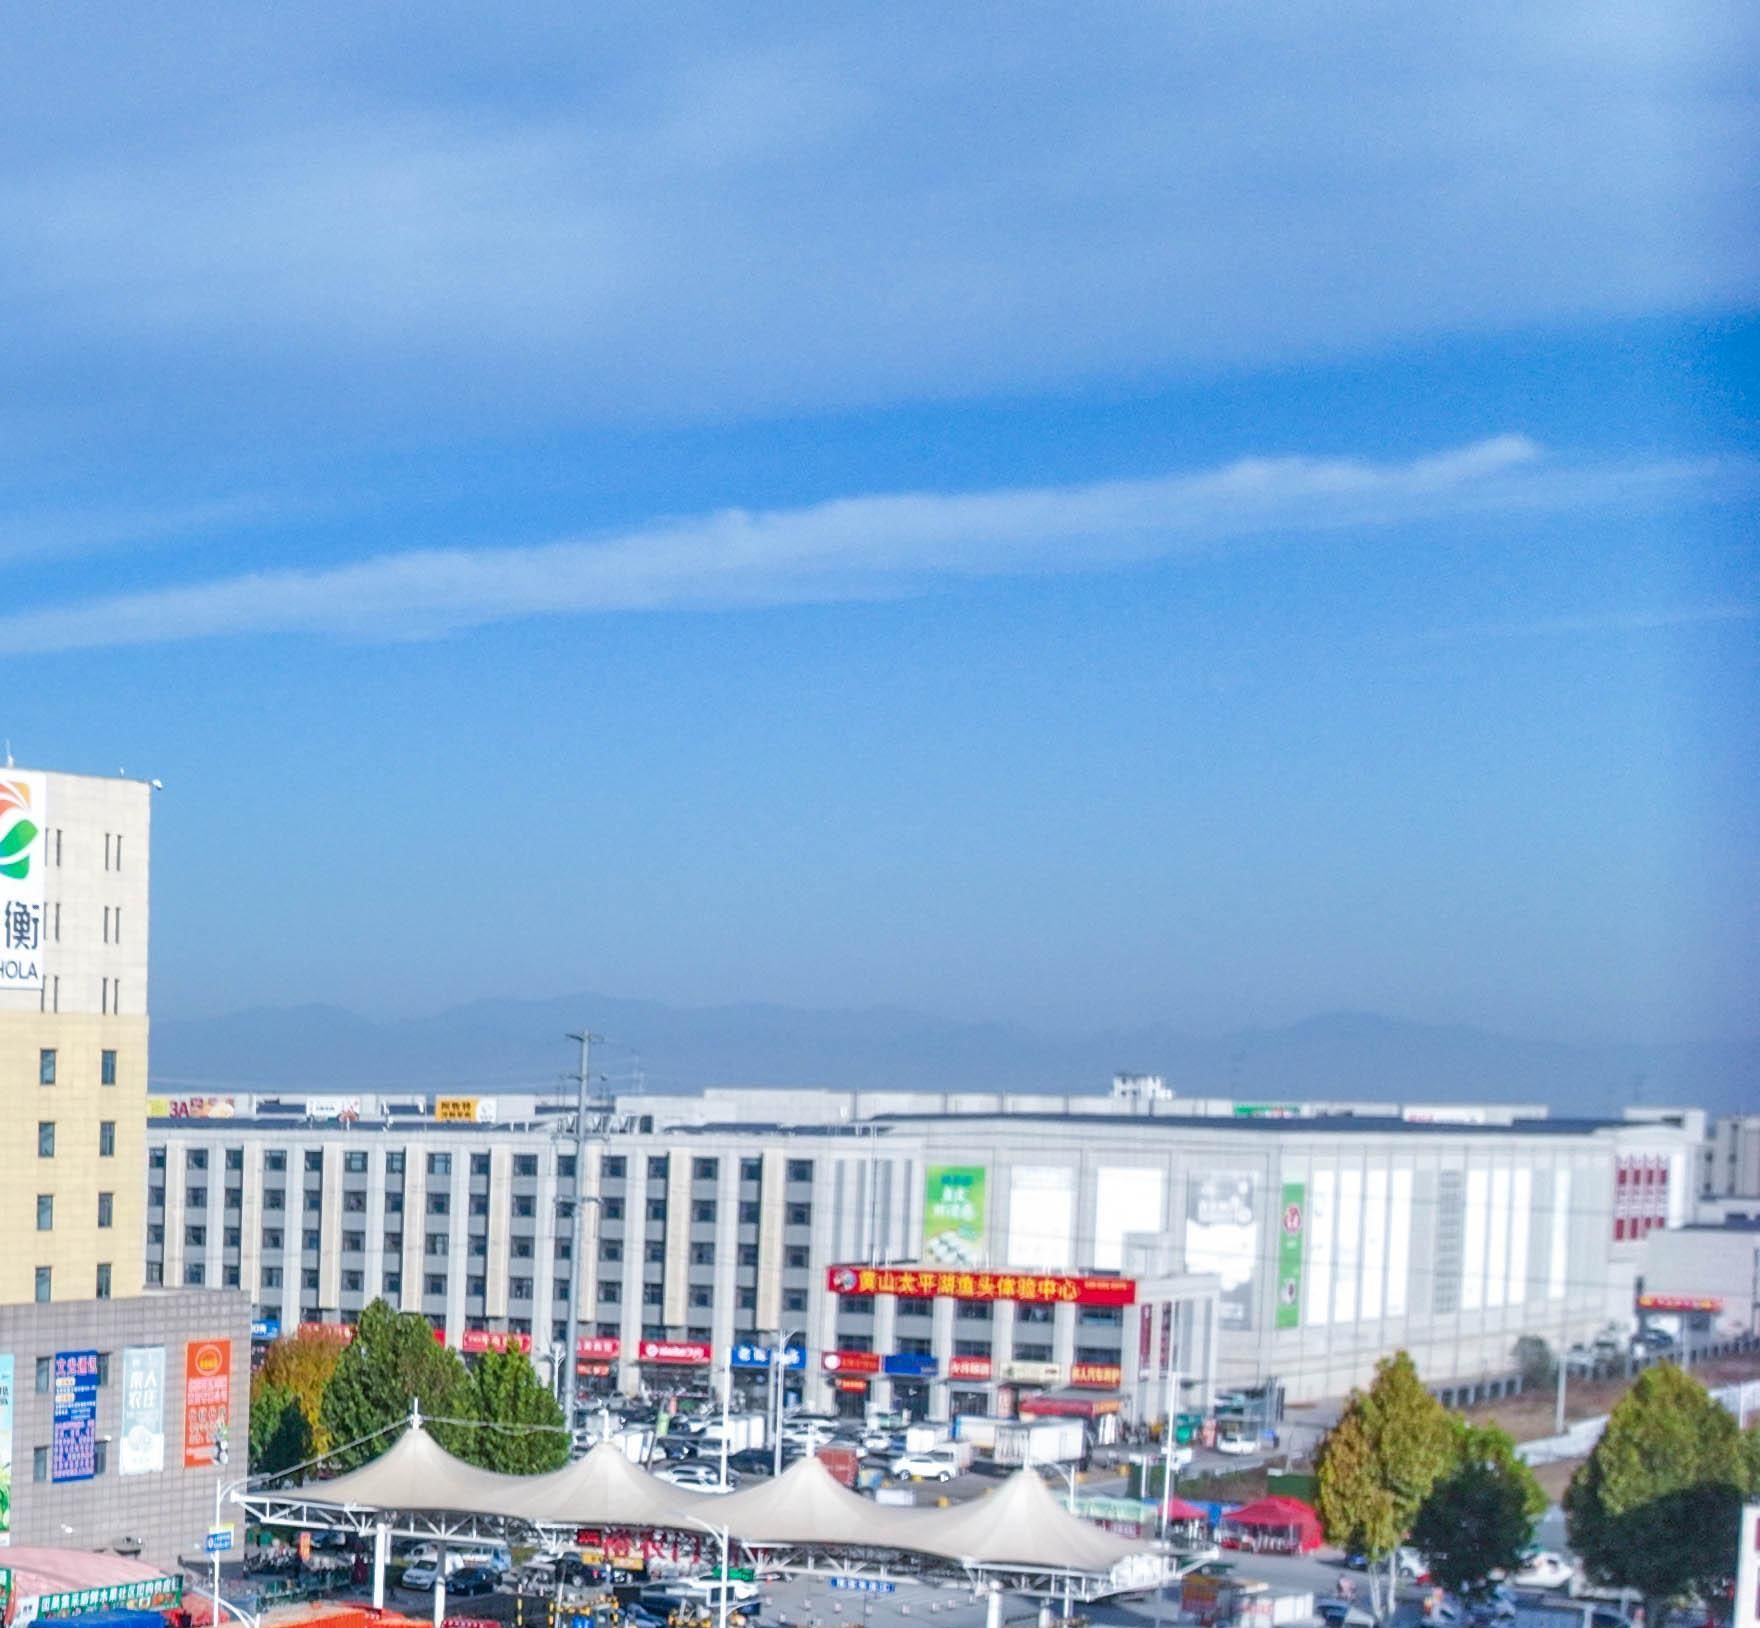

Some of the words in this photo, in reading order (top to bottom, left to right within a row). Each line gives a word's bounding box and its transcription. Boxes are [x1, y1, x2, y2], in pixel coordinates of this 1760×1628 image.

[859, 1271, 1079, 1299] 黄山太平湖鱼头体验中心
